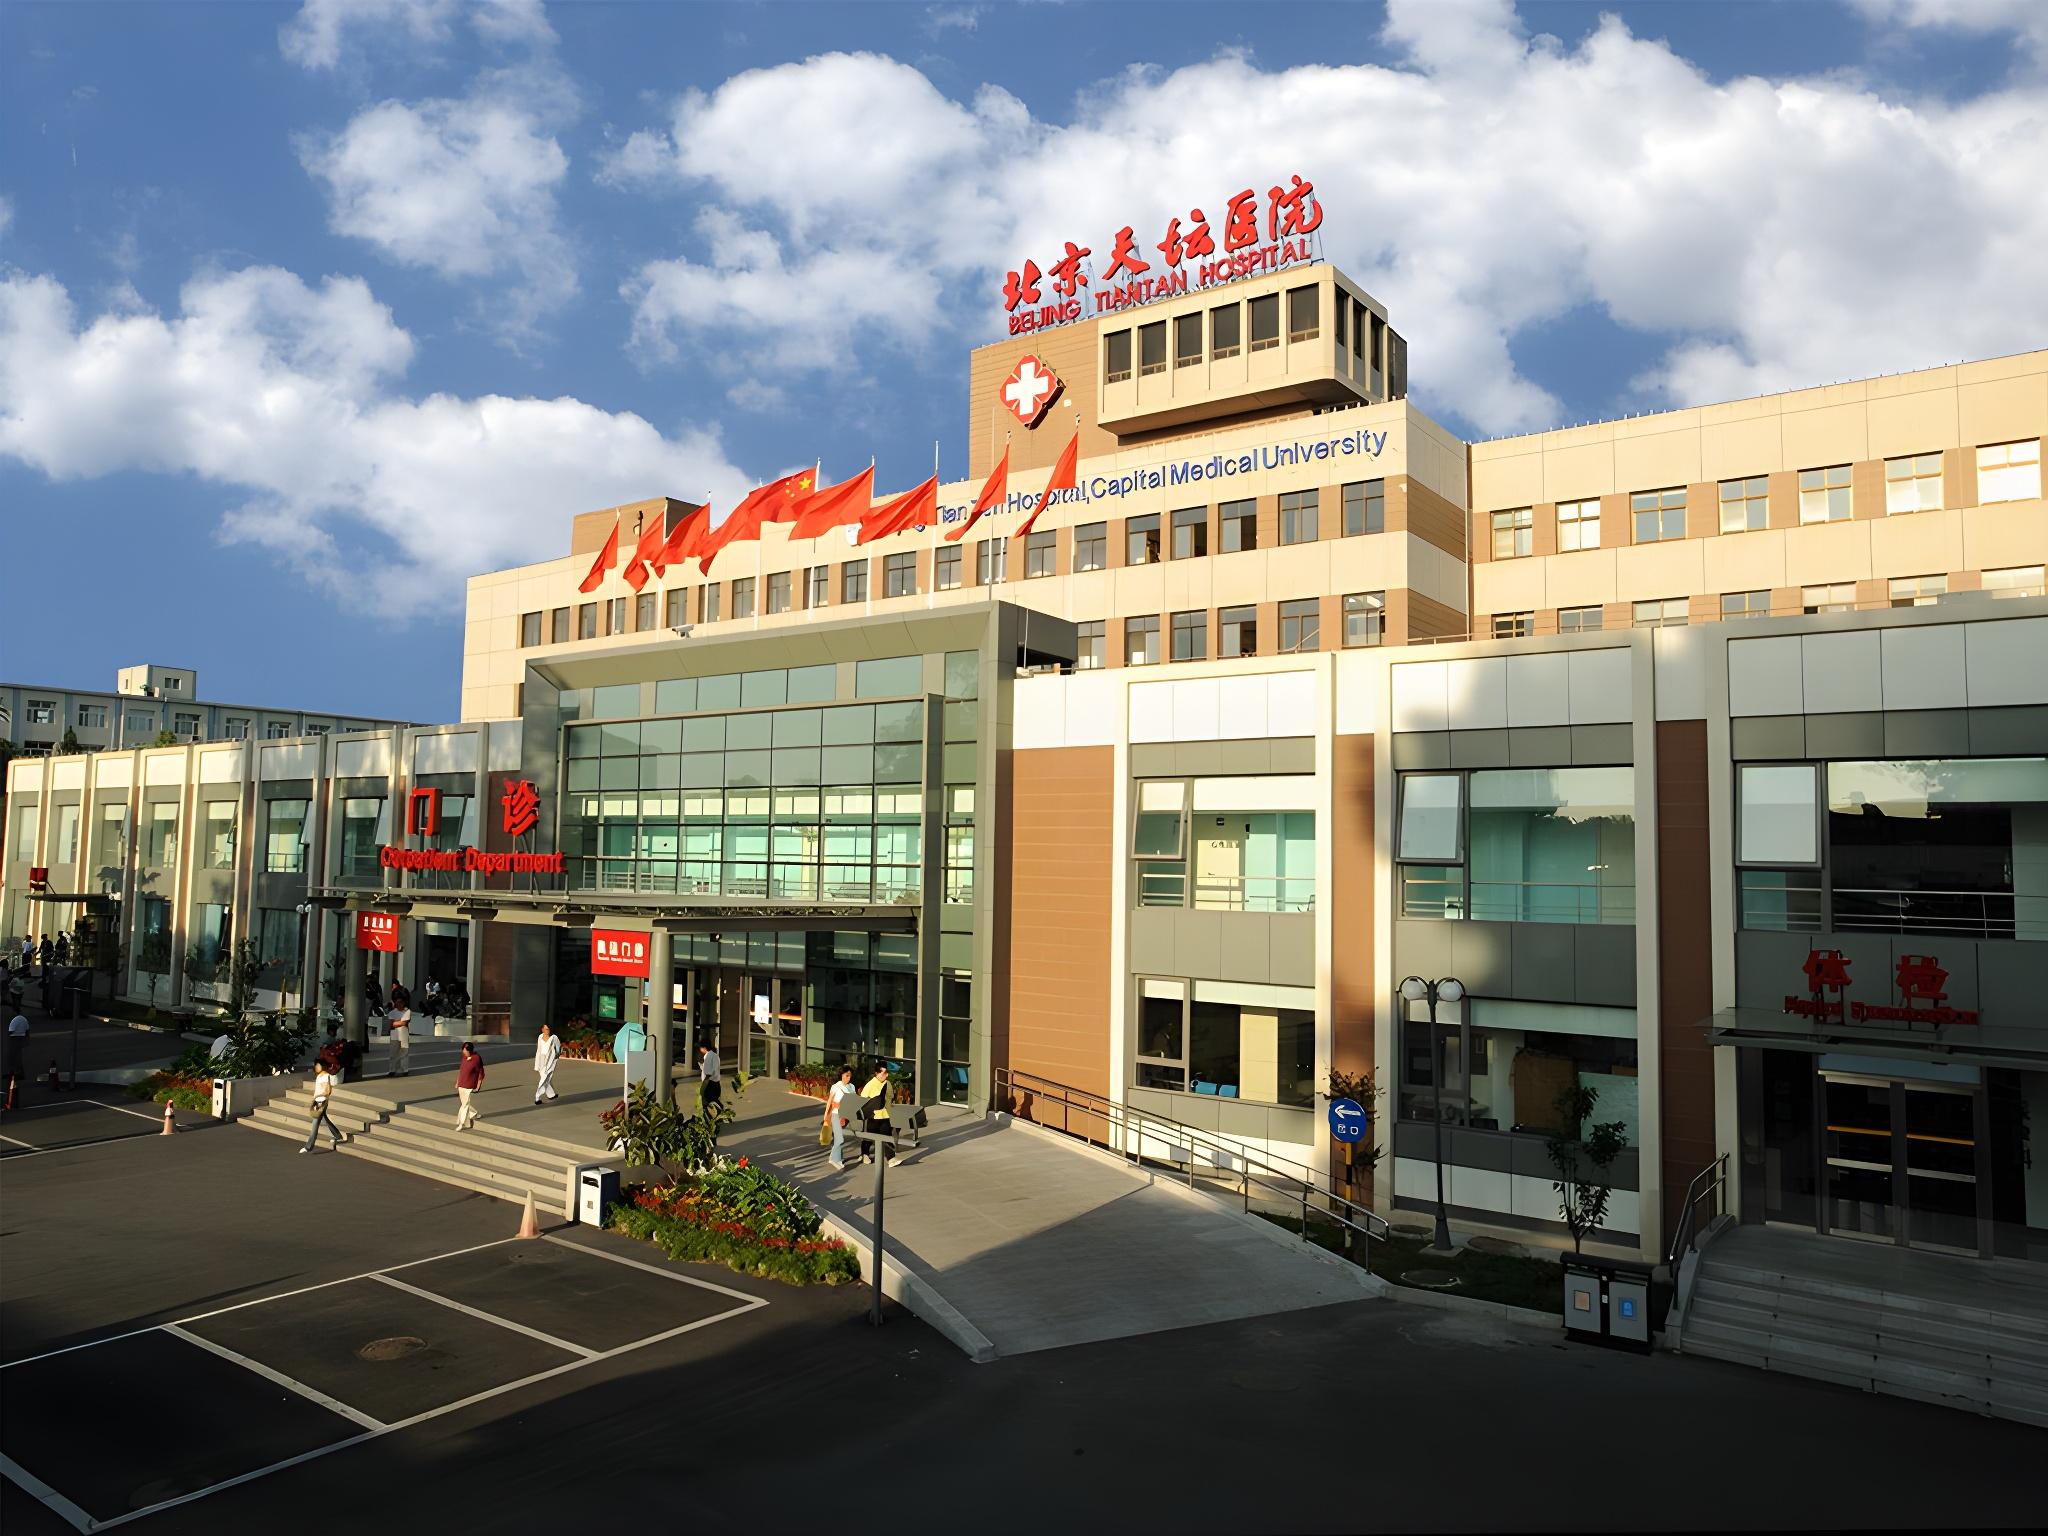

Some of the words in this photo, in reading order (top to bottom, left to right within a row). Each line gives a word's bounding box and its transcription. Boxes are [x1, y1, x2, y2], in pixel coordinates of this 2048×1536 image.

[1003, 174, 1324, 312] 北京天坛医院
[1008, 298, 1082, 336] BEIJING
[1095, 269, 1188, 314] TIANTAN
[1199, 239, 1312, 286] HOSPITAL
[1170, 447, 1258, 486] Medical
[1262, 429, 1388, 470] University
[465, 847, 563, 877] Department
